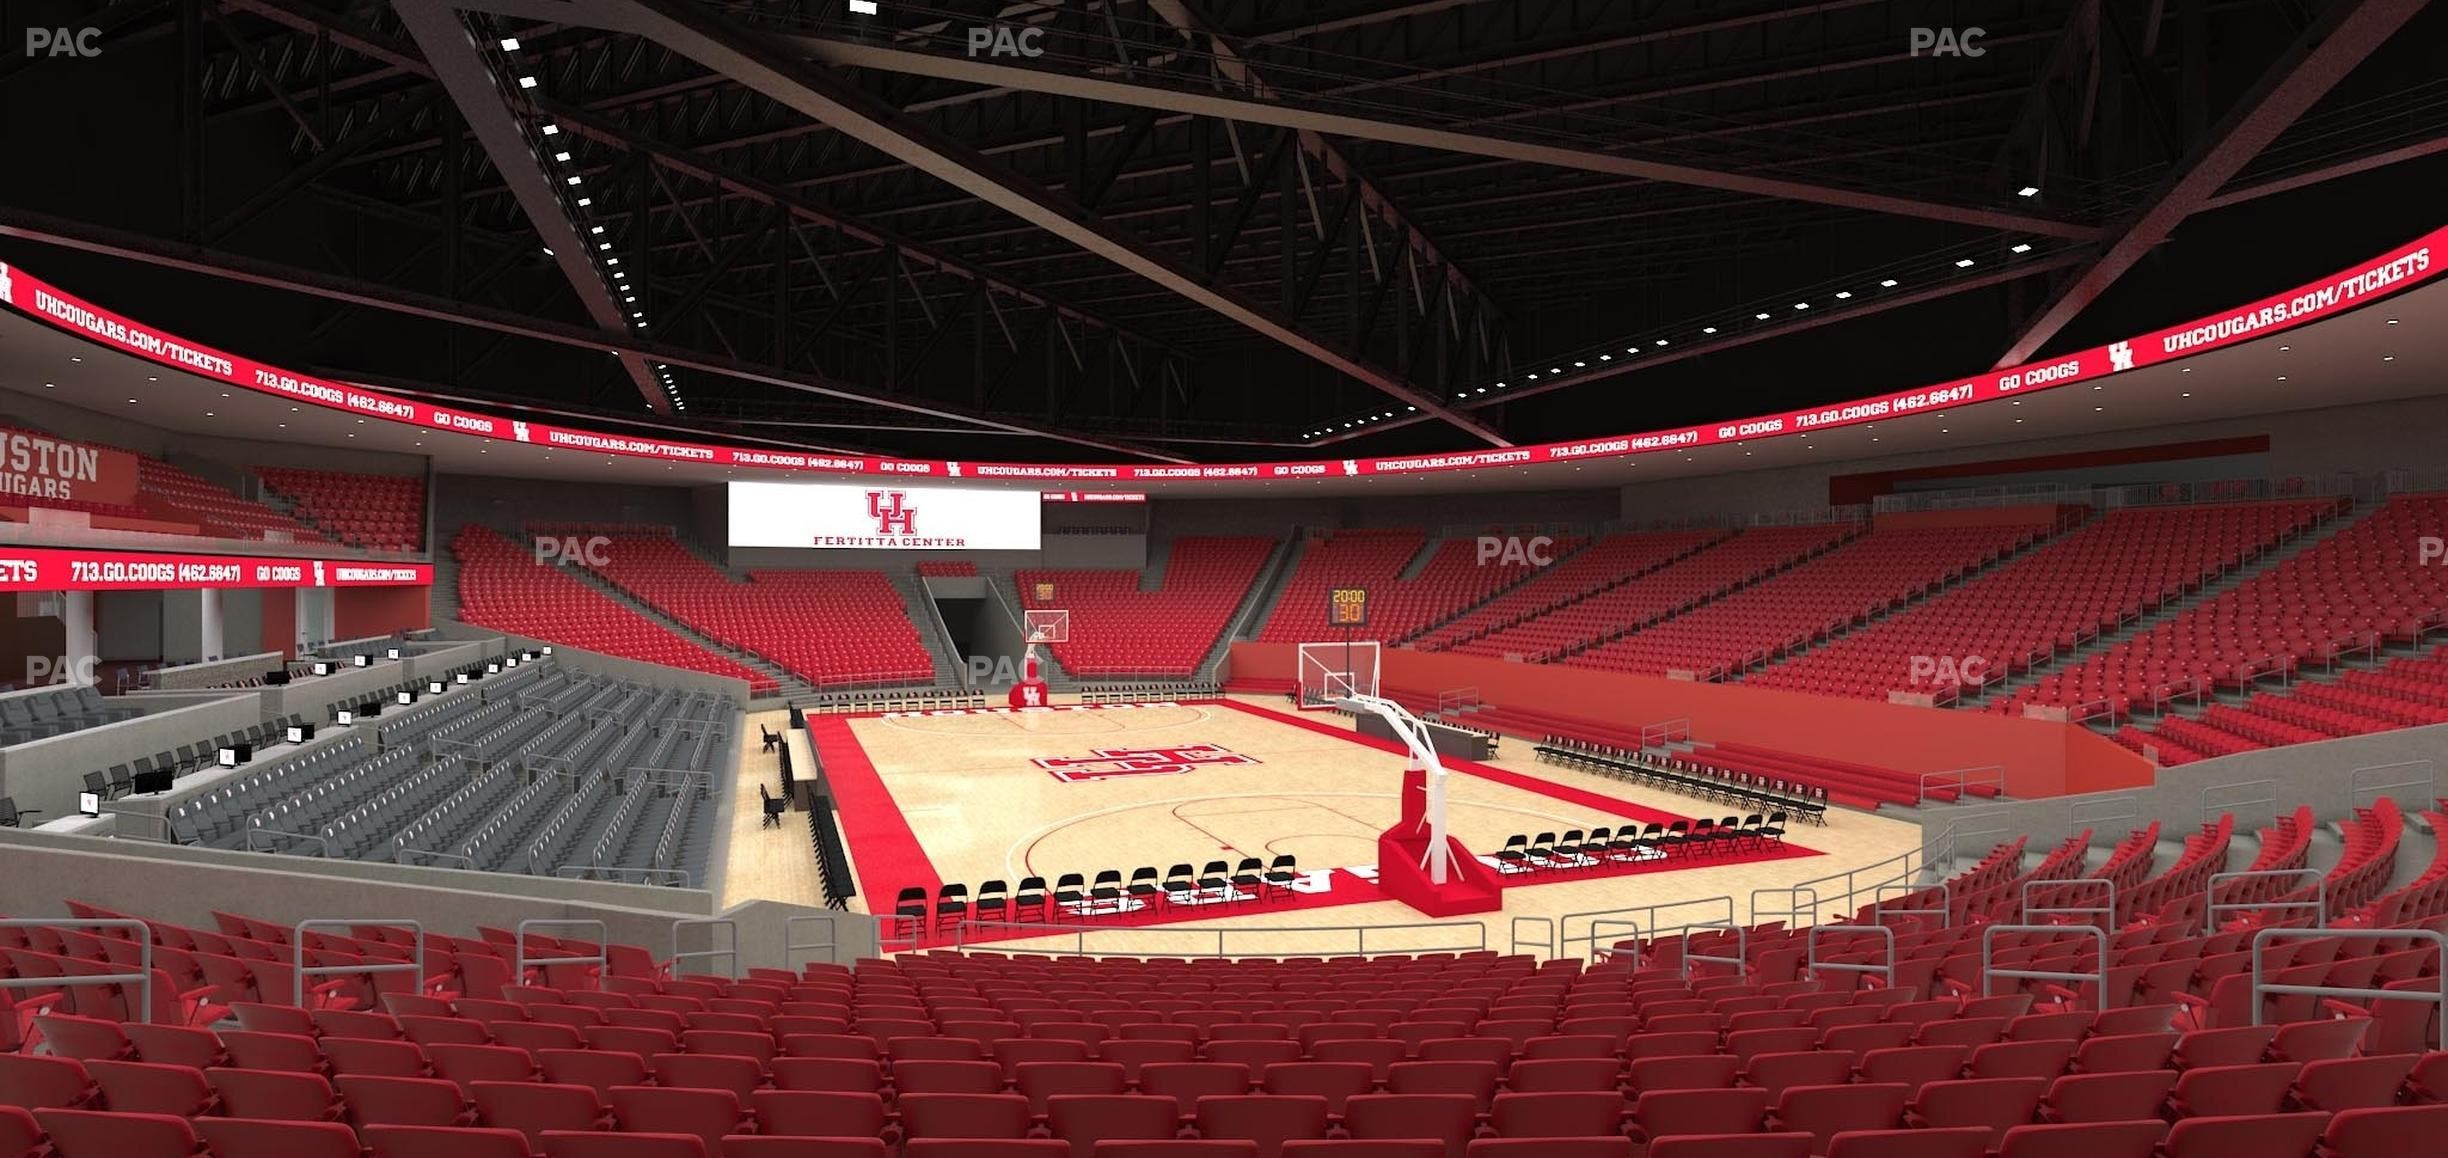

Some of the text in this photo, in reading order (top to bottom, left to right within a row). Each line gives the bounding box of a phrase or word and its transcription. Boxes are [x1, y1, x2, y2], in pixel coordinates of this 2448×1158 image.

[2163, 247, 2430, 353] UHCOUGARS.COM/TICKETS
[35, 289, 233, 376] UHCOUGARS.COM/TICKETS
[255, 369, 344, 404] 713.GO.COOGS
[1999, 360, 2079, 391] GO COOGS
[433, 411, 493, 433] GO COOGS
[1796, 400, 1890, 428] 713.GO.COOGS
[1718, 418, 1783, 439] GO COOGS
[1550, 439, 1629, 458] 713.GO.COOGS
[866, 490, 917, 536] UH
[813, 536, 966, 547] FERTITTA CENTER
[71, 561, 175, 582] 713.GO.COOGS
[1333, 590, 1365, 603] 20:00
[1340, 603, 1360, 621] 30
